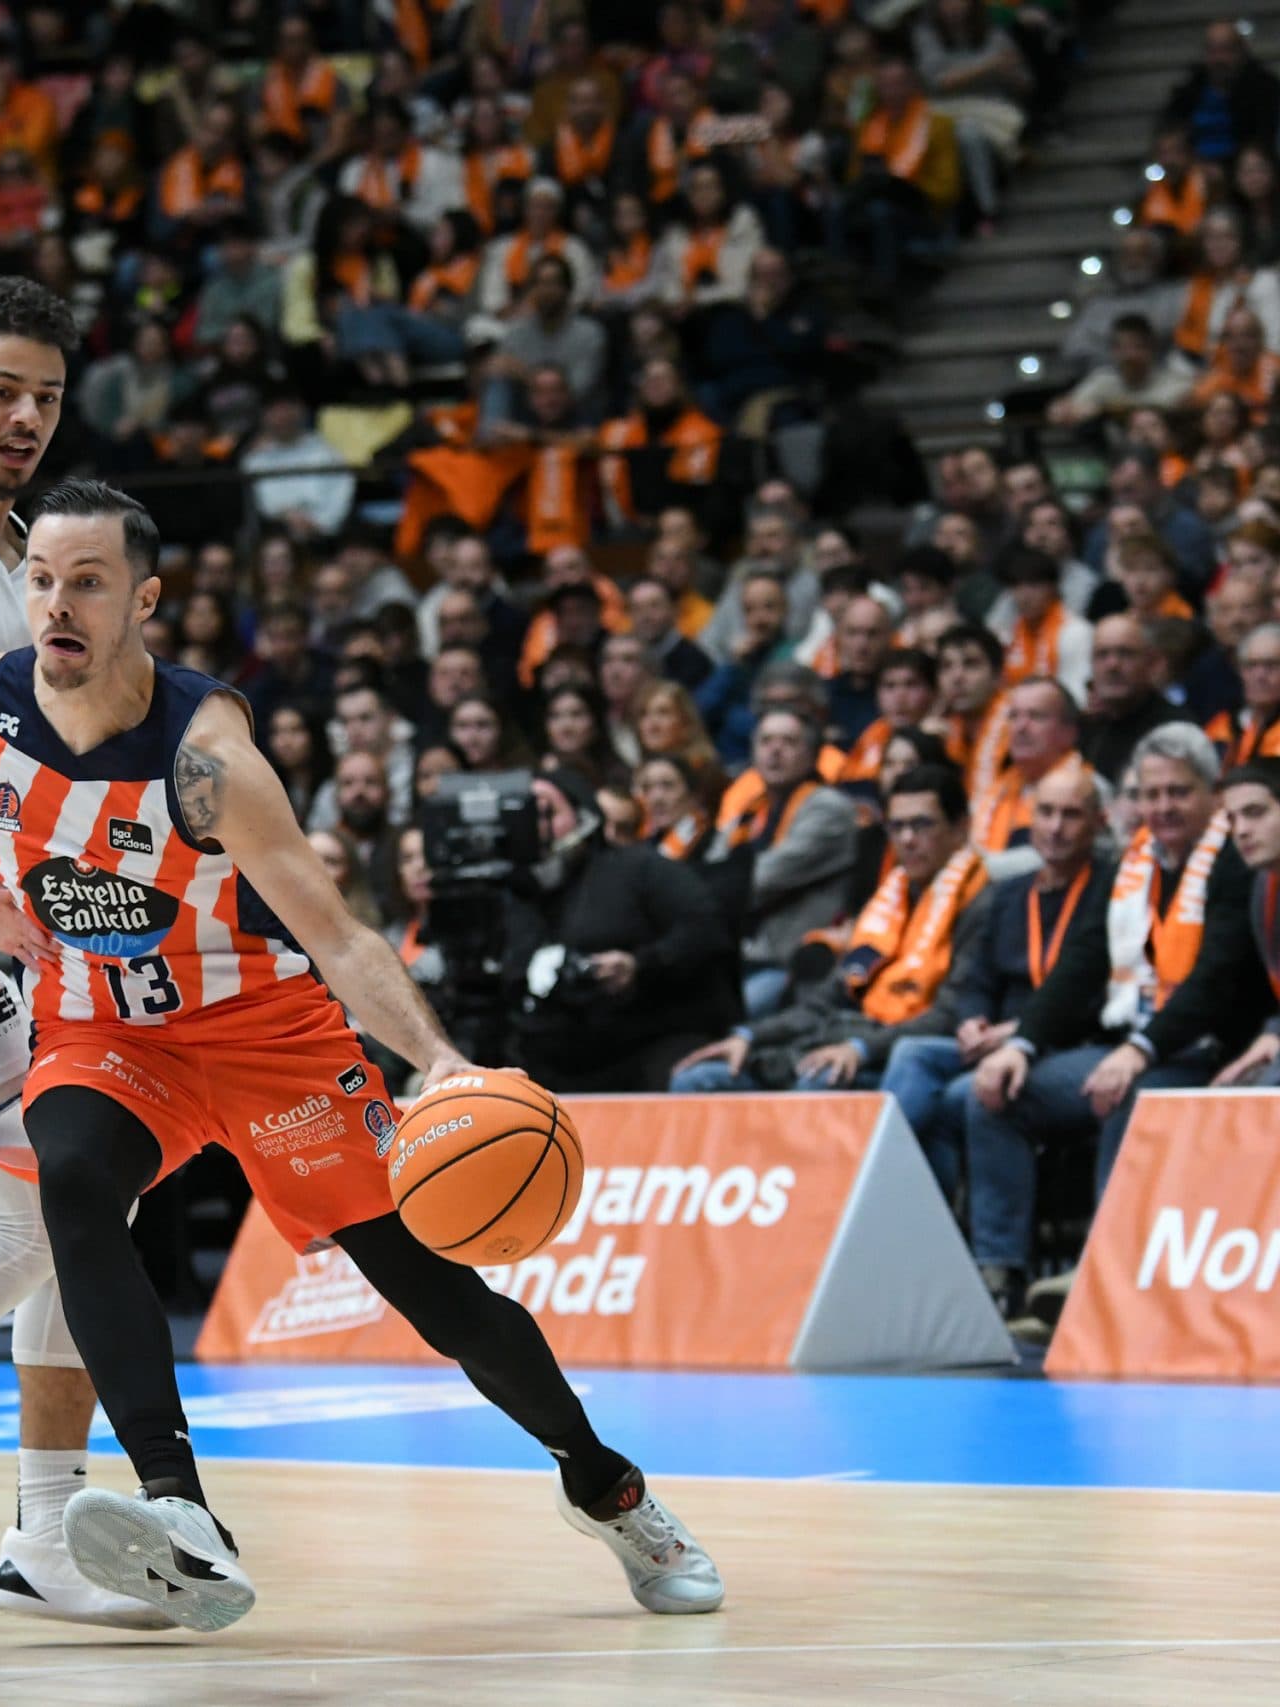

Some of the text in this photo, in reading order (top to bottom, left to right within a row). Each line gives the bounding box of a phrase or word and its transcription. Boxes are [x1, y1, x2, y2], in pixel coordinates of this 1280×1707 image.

[112, 827, 131, 840] liga
[112, 838, 152, 852] endesa
[41, 873, 148, 906] Estrella
[50, 902, 151, 931] Galicia
[102, 955, 183, 1020] 13
[345, 1075, 364, 1092] acb
[249, 1094, 332, 1137] A Coruña
[254, 1111, 345, 1152] UNHA PROVINCIA
[262, 1123, 348, 1159] POR DESCUBRIR
[406, 1114, 473, 1157] endesa
